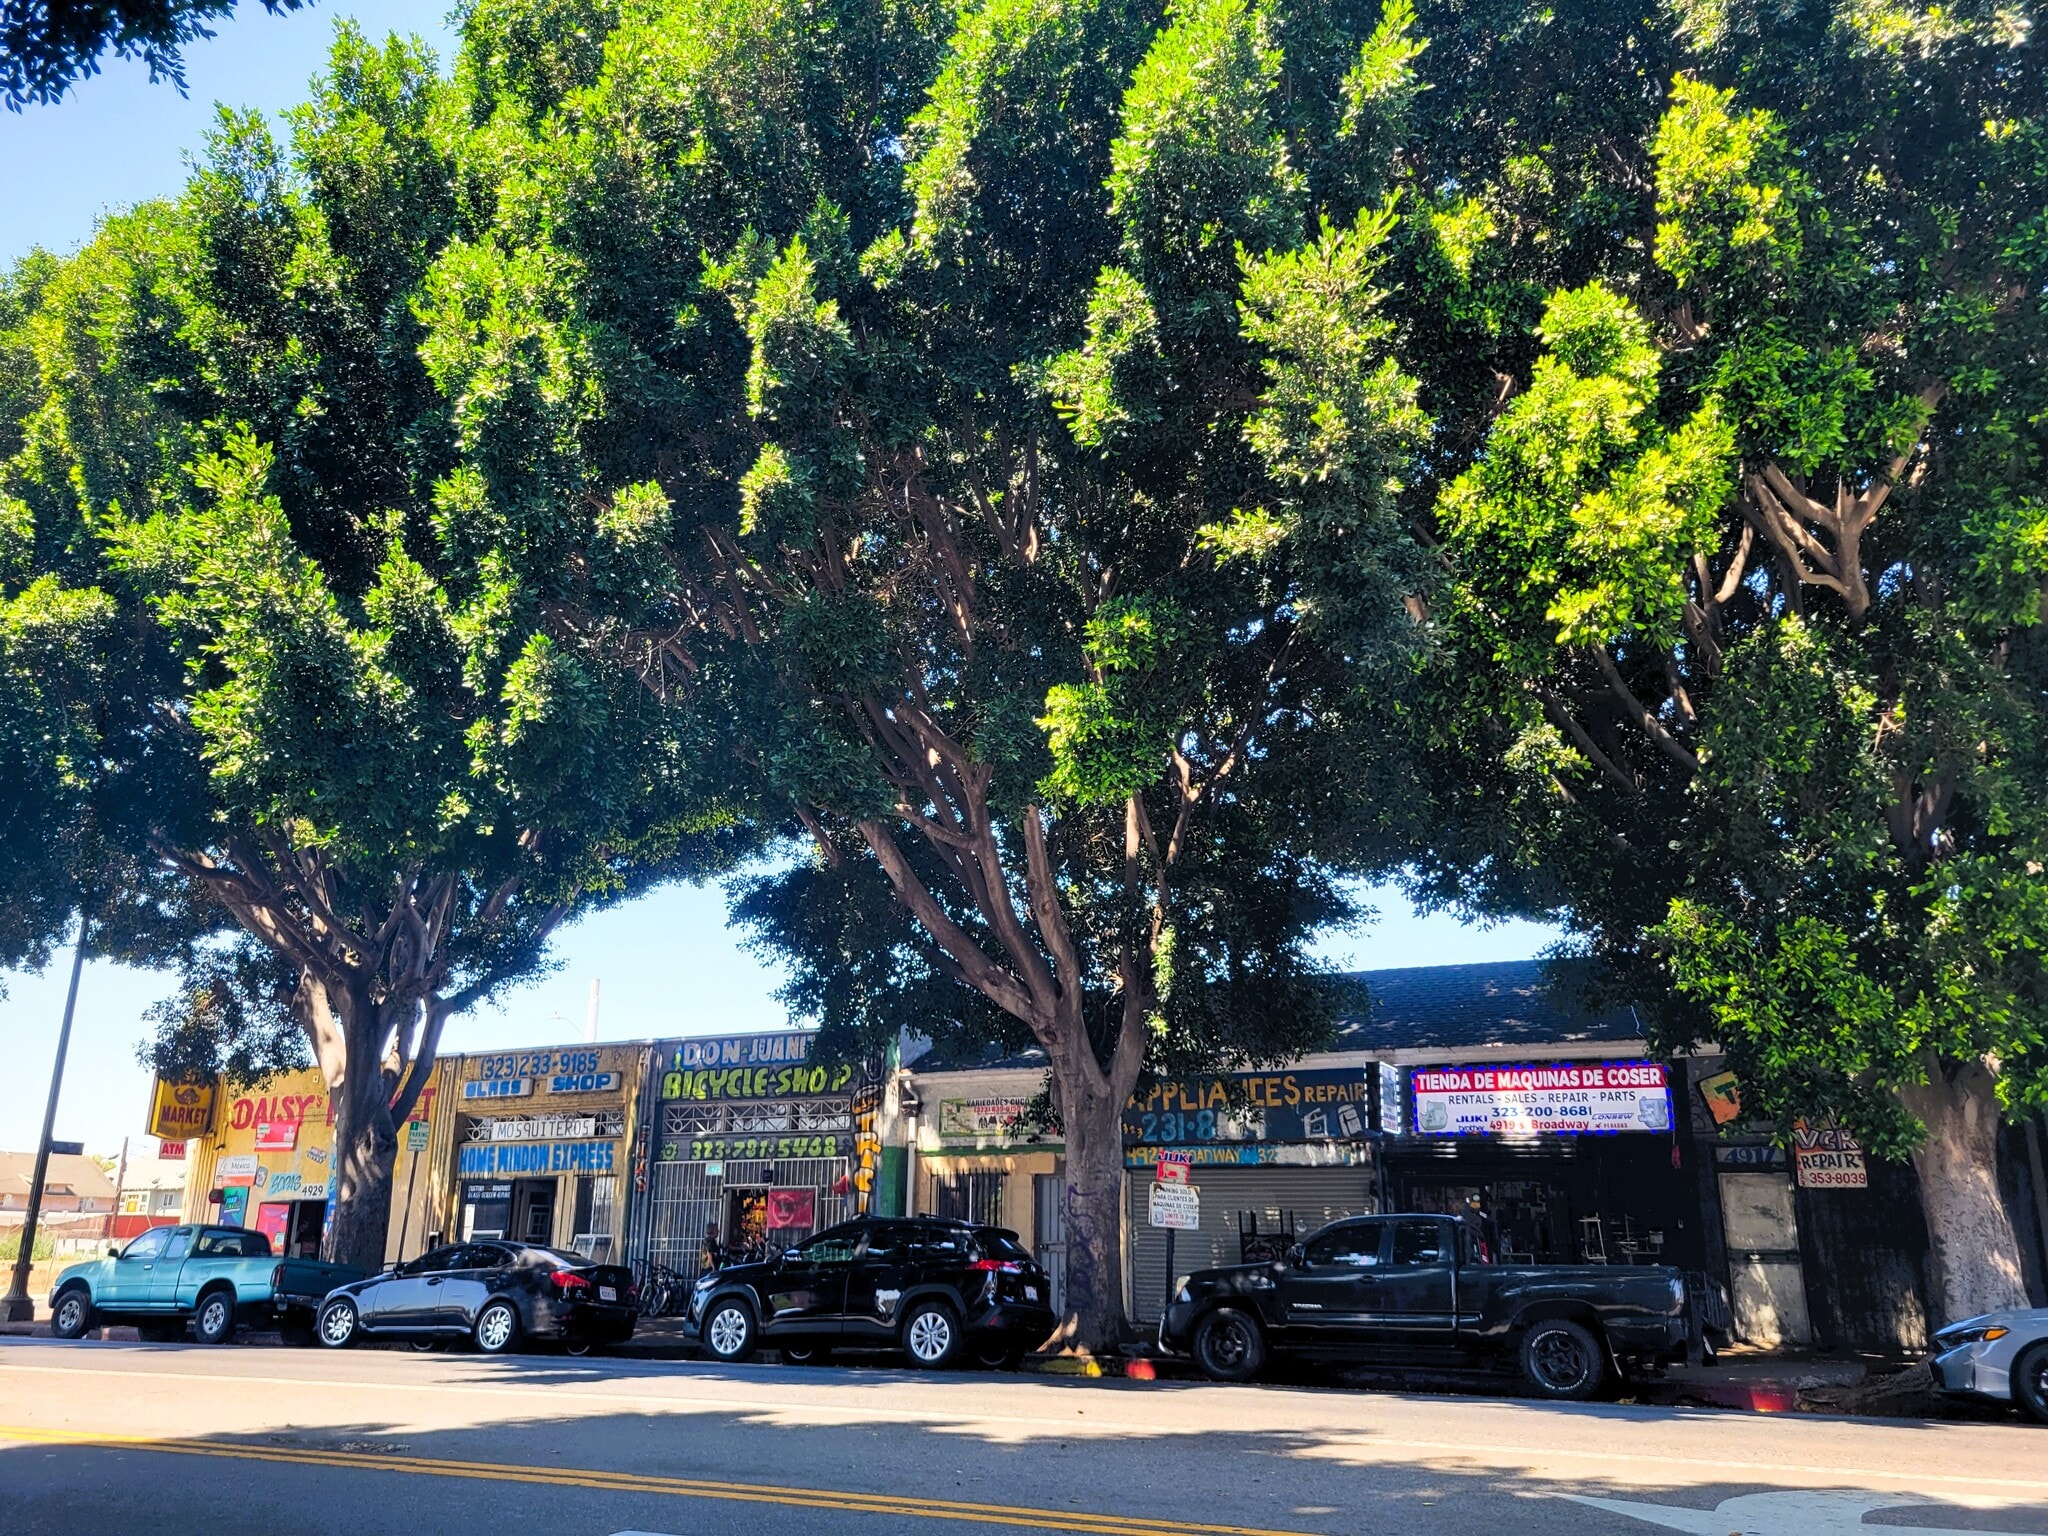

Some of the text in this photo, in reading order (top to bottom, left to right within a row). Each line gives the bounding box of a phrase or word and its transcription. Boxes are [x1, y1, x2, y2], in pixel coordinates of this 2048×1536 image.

[682, 1033, 816, 1067] DON JUANI
[465, 1073, 612, 1098] GLASS SHOP
[661, 1062, 853, 1100] BICYCLE SHOP
[1416, 1067, 1662, 1091] TIENDA DE MAQUINAS DE COSER
[1304, 1082, 1366, 1103] REPAIR
[1448, 1090, 1636, 1104] RENTALS SALES REPAIR PARTS
[161, 1104, 208, 1125] MARKET
[1456, 1114, 1488, 1123] JUKI
[1491, 1105, 1592, 1118] 323-200-8681
[1592, 1112, 1635, 1121] CONSEW
[496, 1119, 590, 1138] MOSQUITEROS
[1489, 1120, 1515, 1130] 4919
[1531, 1119, 1590, 1132] Broadway
[1793, 1128, 1861, 1151] VCR
[161, 1142, 185, 1155] ATM
[459, 1140, 615, 1173] HOME WINDOW EXPRESS
[1723, 1147, 1777, 1163] 4917
[1157, 1151, 1193, 1164] JUKI
[1801, 1153, 1860, 1169] REPAIR
[270, 1174, 303, 1194] SODAS
[1809, 1172, 1866, 1185] 353-8039
[301, 1185, 324, 1197] 4929
